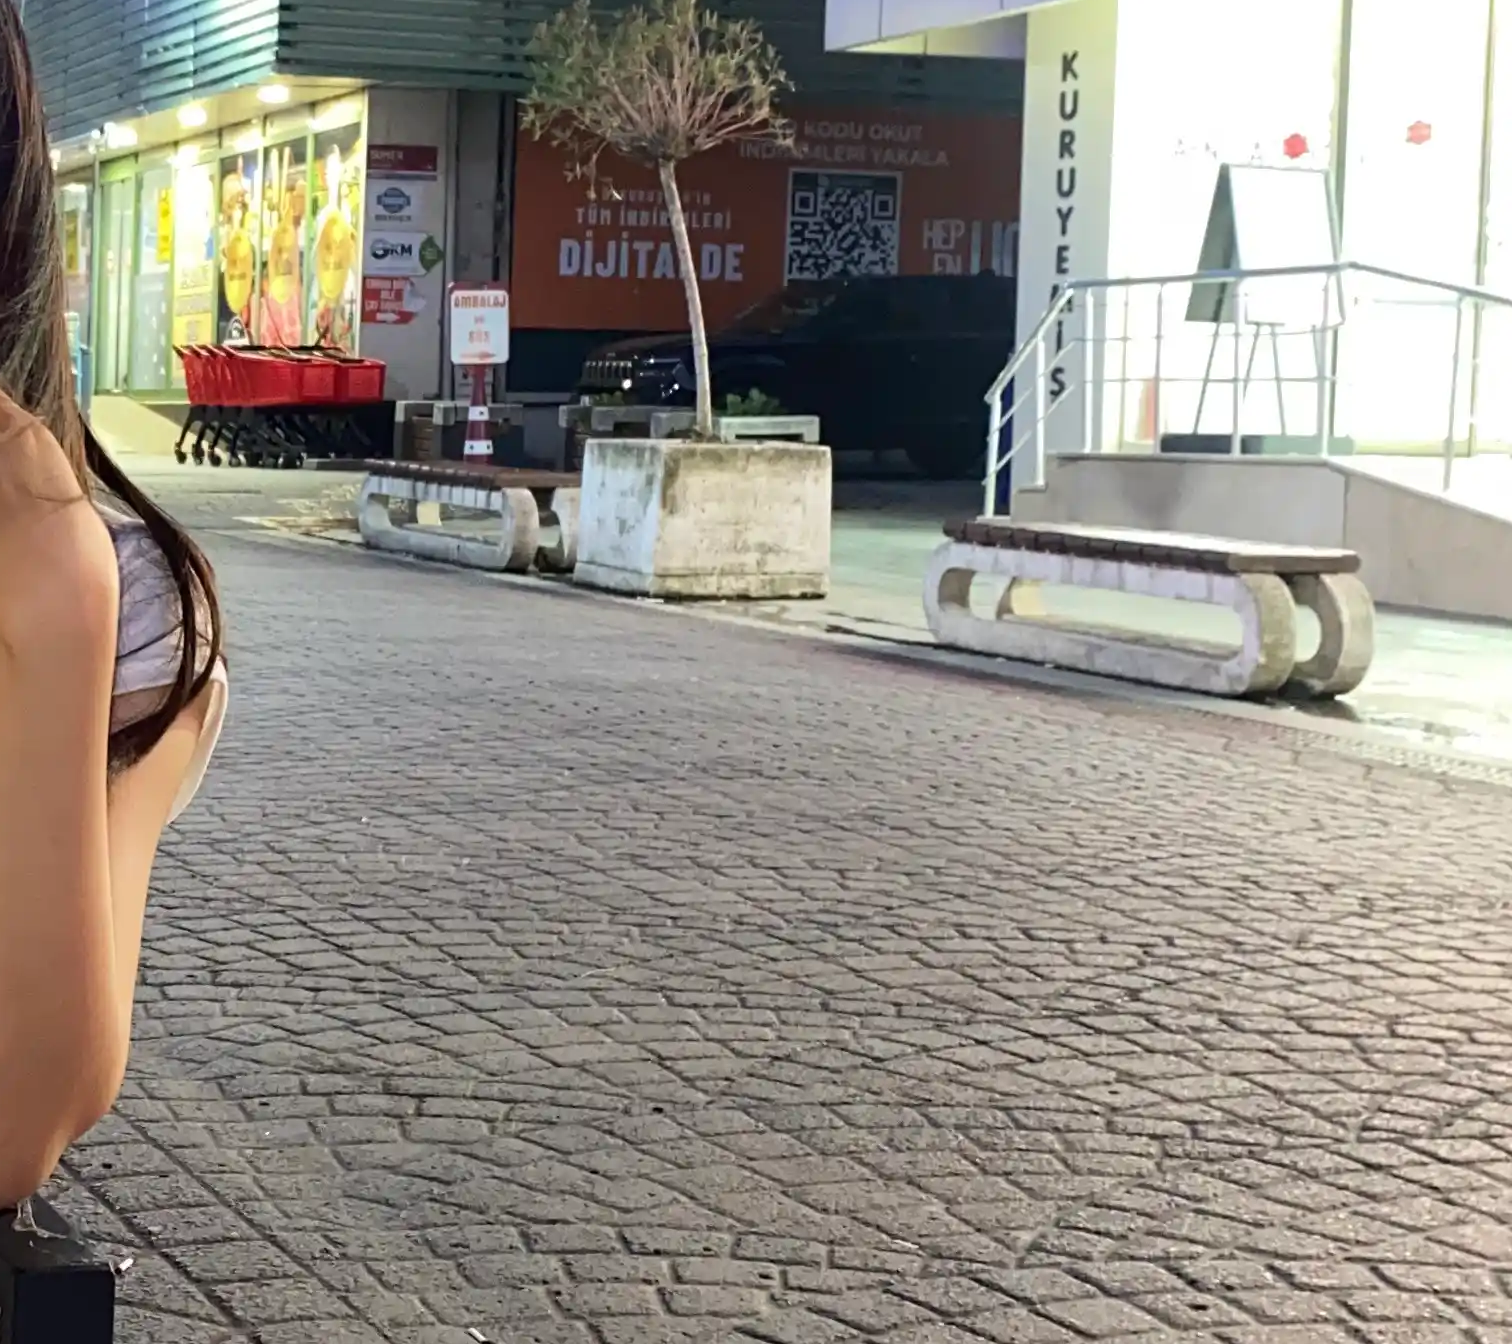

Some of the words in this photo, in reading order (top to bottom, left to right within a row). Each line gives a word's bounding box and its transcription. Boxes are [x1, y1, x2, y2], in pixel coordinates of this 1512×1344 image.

[804, 120, 864, 140] KODU
[576, 202, 612, 226] TÜM
[619, 205, 731, 230] İNDİRLERİ
[558, 228, 745, 282] DİJİTADE
